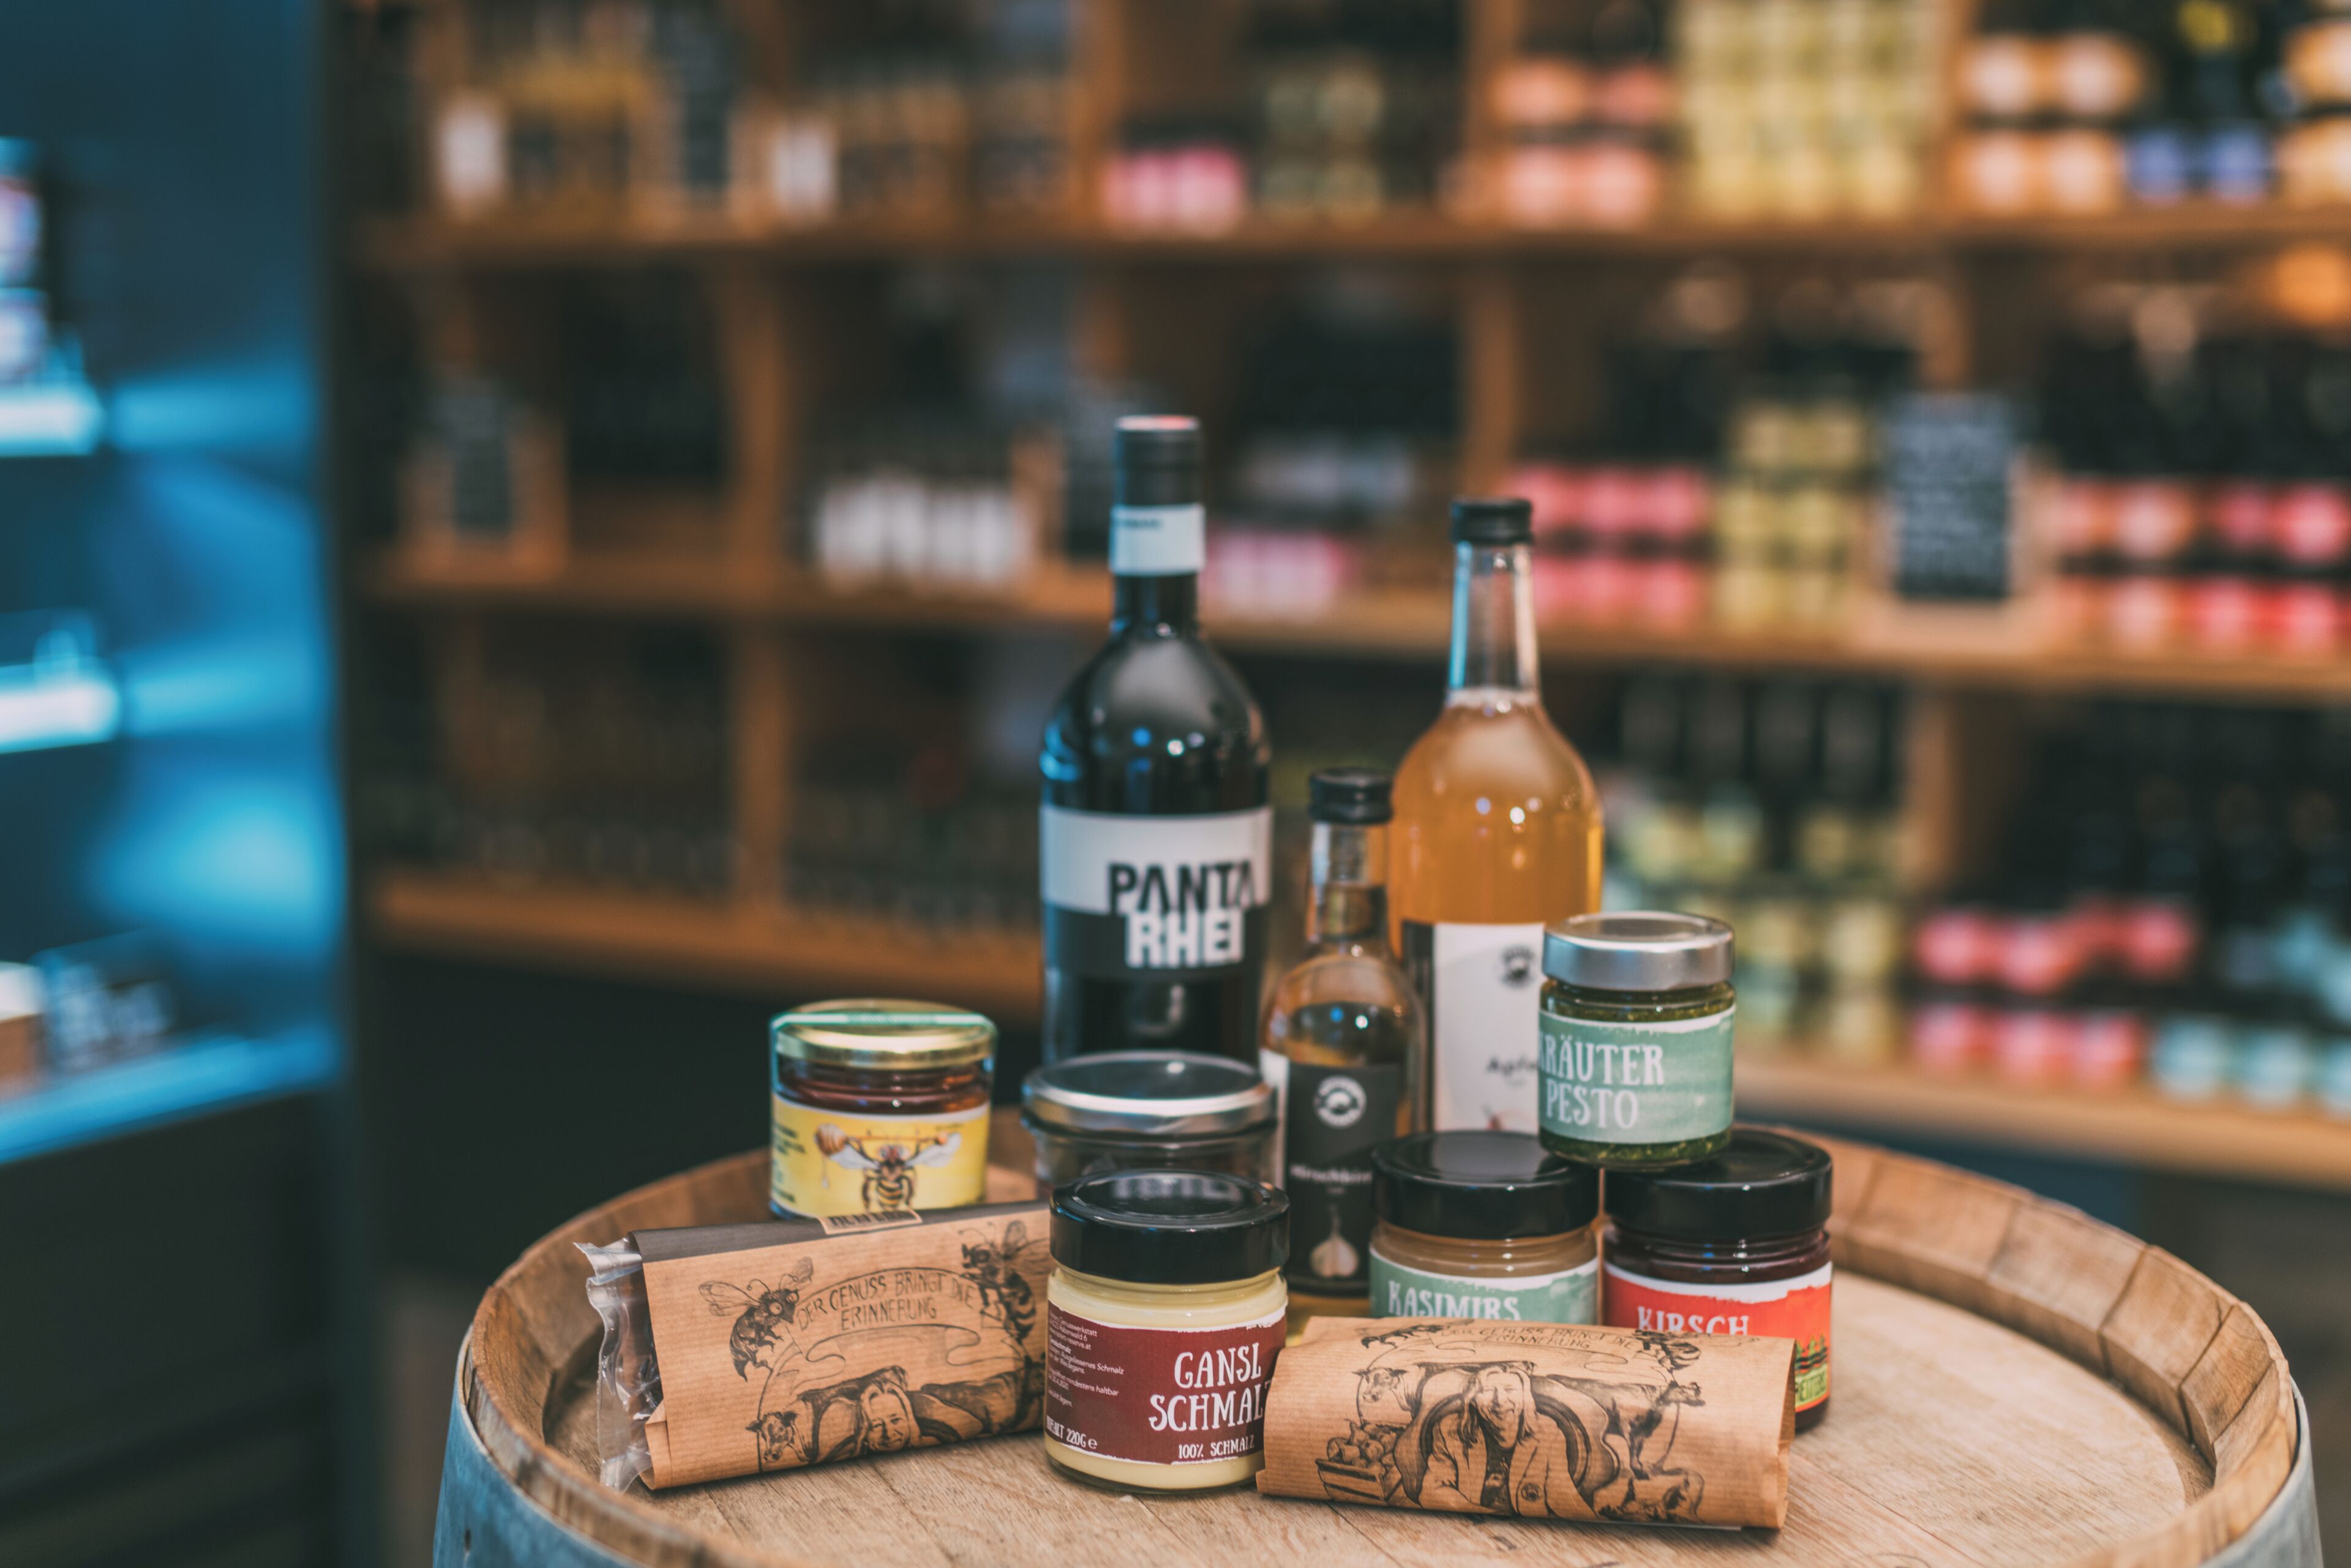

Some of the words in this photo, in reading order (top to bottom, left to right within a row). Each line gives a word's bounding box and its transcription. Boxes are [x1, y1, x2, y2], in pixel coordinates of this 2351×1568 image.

[1108, 860, 1254, 914] PANTA
[1547, 1078, 1638, 1130] PESTO
[797, 1298, 828, 1332] DER
[830, 1275, 887, 1311] GENUSS
[894, 1271, 948, 1297] BRINGT
[950, 1277, 978, 1309] DIE
[841, 1297, 937, 1332] ERINNERUNG
[1388, 1280, 1521, 1320] KASIMIRS
[1637, 1306, 1750, 1335] KIRSCH
[1484, 1334, 1590, 1349] ERINNERUNG
[1552, 1329, 1607, 1340] BRINGT
[1612, 1335, 1638, 1350] DIE
[1097, 1363, 1124, 1375] Schmalz
[1174, 1342, 1262, 1389] GANSL
[1095, 1385, 1119, 1397] haltbar
[1066, 1428, 1086, 1448] 220G
[1179, 1443, 1204, 1459] 100%
[1210, 1435, 1254, 1457] SCHMALZ
